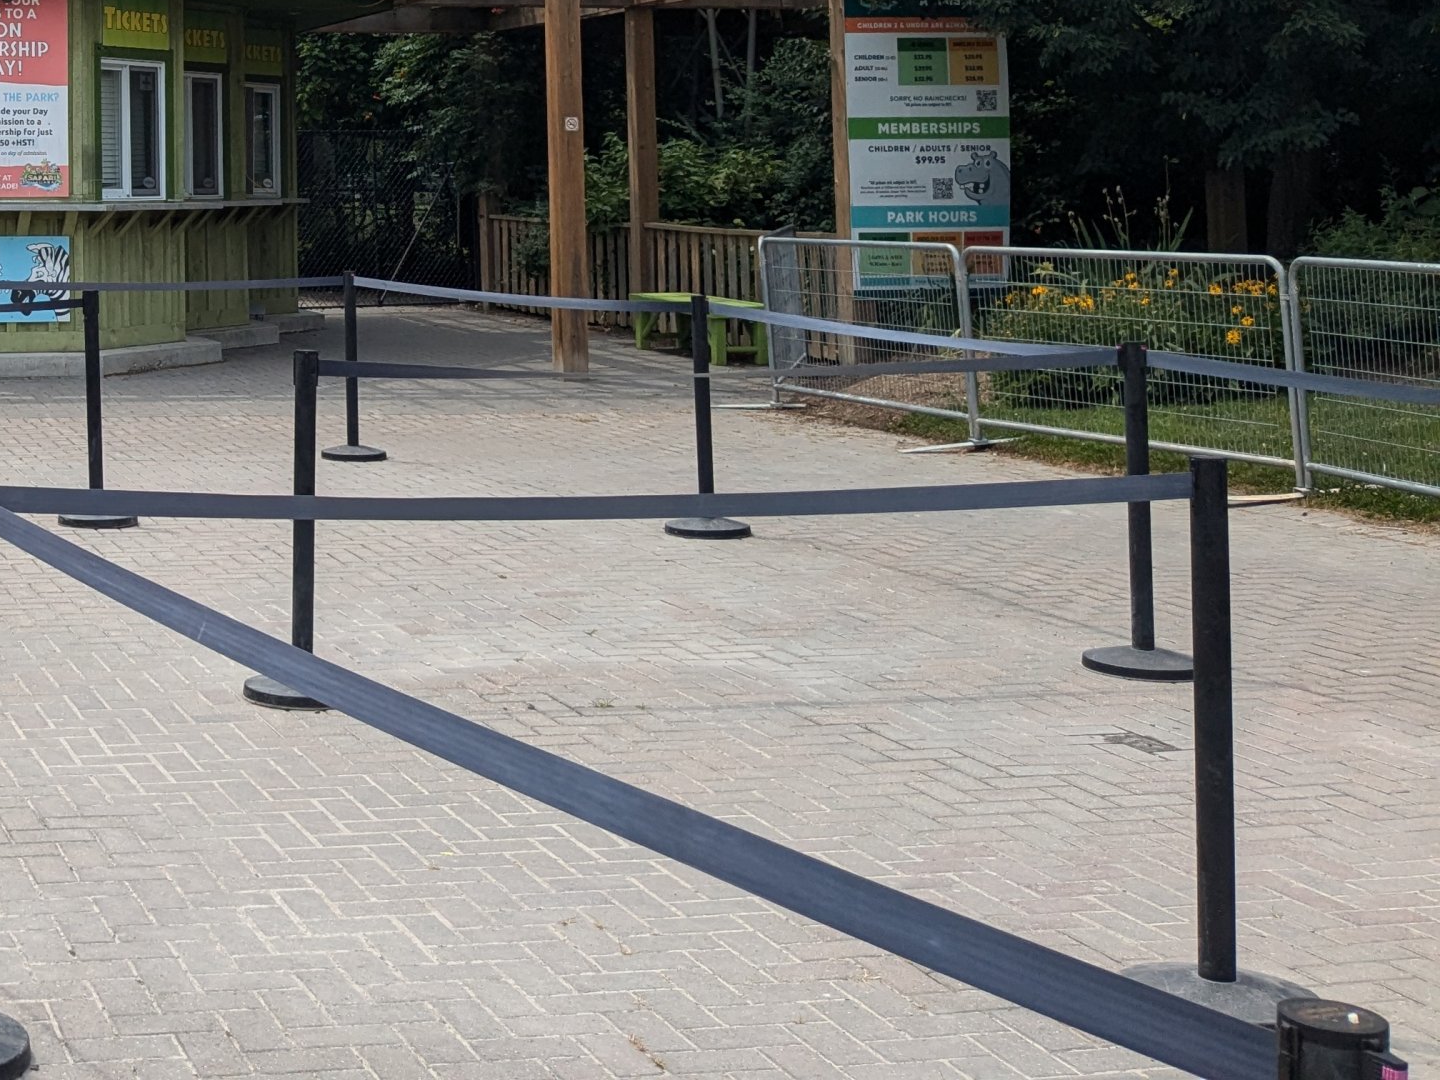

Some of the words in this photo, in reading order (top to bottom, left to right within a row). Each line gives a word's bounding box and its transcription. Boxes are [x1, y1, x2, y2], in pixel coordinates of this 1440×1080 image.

[4, 8, 23, 19] TO
[26, 8, 37, 19] A
[103, 6, 168, 34] TICKETS
[184, 28, 225, 48] CKETS
[3, 92, 22, 102] THE
[26, 92, 60, 102] PARK?
[32, 108, 48, 117] Day
[23, 128, 36, 136] for
[37, 128, 53, 137] just
[877, 122, 981, 135] MEMBERSHIPS
[868, 145, 911, 153] CHILDREN
[915, 155, 946, 165] $99.95
[887, 211, 925, 224] PARK
[928, 210, 978, 223] HOURS
